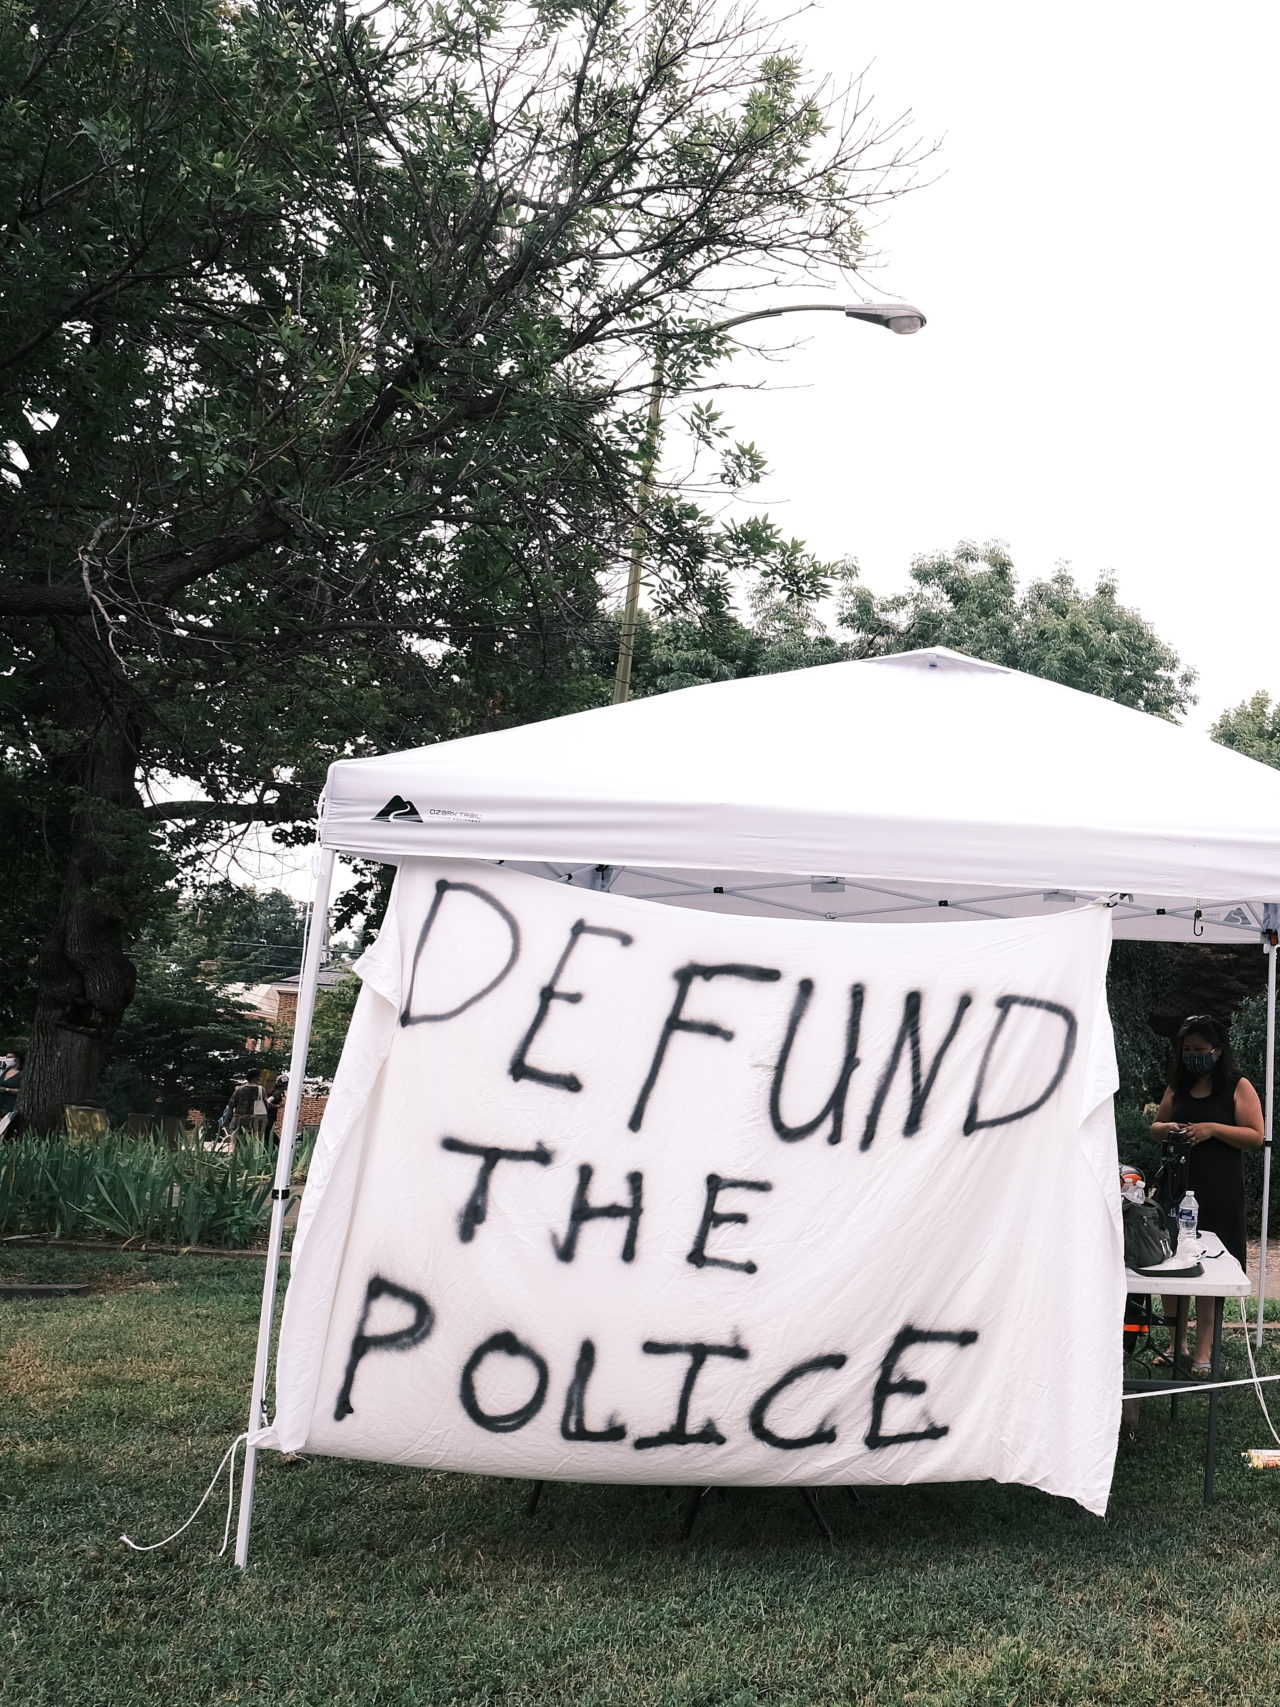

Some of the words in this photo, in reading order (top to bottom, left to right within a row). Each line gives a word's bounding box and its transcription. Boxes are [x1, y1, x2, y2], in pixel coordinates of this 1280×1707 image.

[399, 878, 1081, 1152] DEFUND
[439, 1133, 774, 1274] THE
[332, 1275, 979, 1452] POLICE
